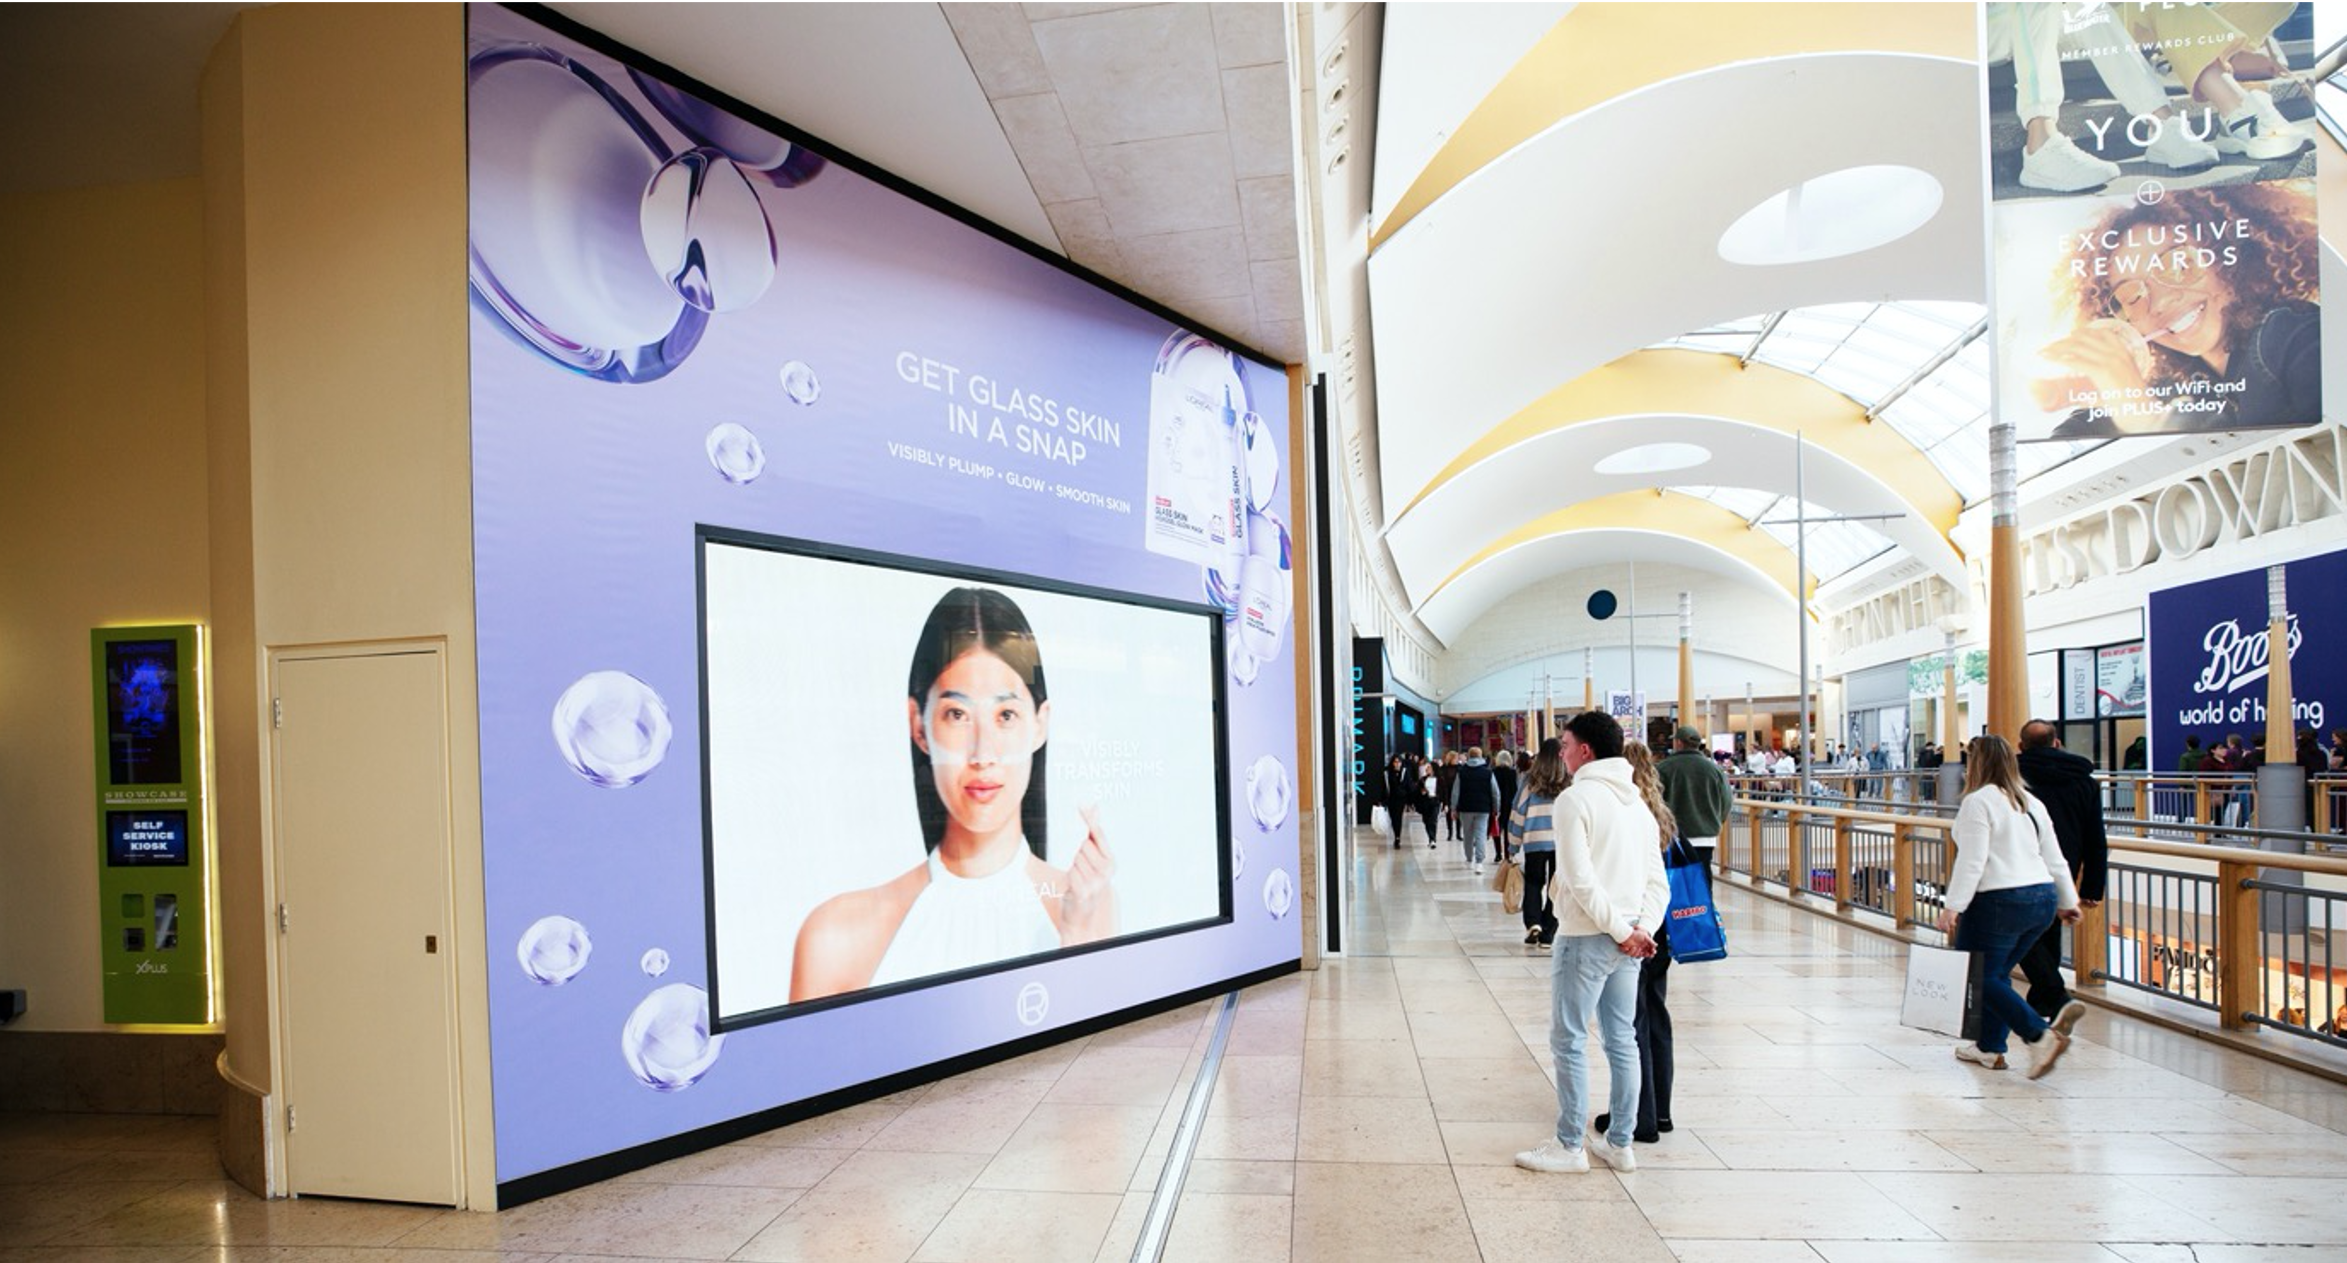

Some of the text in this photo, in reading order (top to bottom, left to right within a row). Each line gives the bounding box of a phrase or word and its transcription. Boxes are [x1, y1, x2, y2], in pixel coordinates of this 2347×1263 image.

[2062, 32, 2235, 60] MEMBER REWARDS CLUB
[2085, 107, 2212, 151] YOU
[2058, 218, 2250, 253] EXCLUSIVE
[2070, 246, 2238, 278] REWARDS
[896, 351, 1121, 448] GET GLASS SKIN
[2101, 390, 2122, 400] on
[2125, 387, 2143, 398] to
[2145, 385, 2173, 397] our
[2175, 380, 2210, 396] WiFi
[2214, 378, 2247, 393] and
[2087, 406, 2118, 422] join
[2177, 398, 2227, 414] today
[949, 402, 1087, 467] IN A SNAP
[887, 441, 946, 467] VISIBLY
[949, 457, 995, 480] PLUMP
[1006, 471, 1045, 493] GLOW
[1056, 484, 1105, 508] SMOOTH
[1106, 497, 1131, 514] SKIN
[2107, 424, 2347, 576] DOWN
[1613, 695, 1631, 706] BIG
[2074, 667, 2085, 715] DENTIST
[2180, 697, 2325, 729] world of hing
[1352, 666, 1365, 796] PRIMARK
[1080, 740, 1141, 759] VISIBLY
[1053, 759, 1166, 781] TRANSFORMS
[105, 790, 187, 798] SHOWCASE
[122, 831, 175, 841] SERVICE
[133, 821, 163, 830] SELF
[130, 842, 168, 850] KIOSK
[1912, 988, 1949, 1001] LOOK
[1917, 978, 1947, 991] NEW
